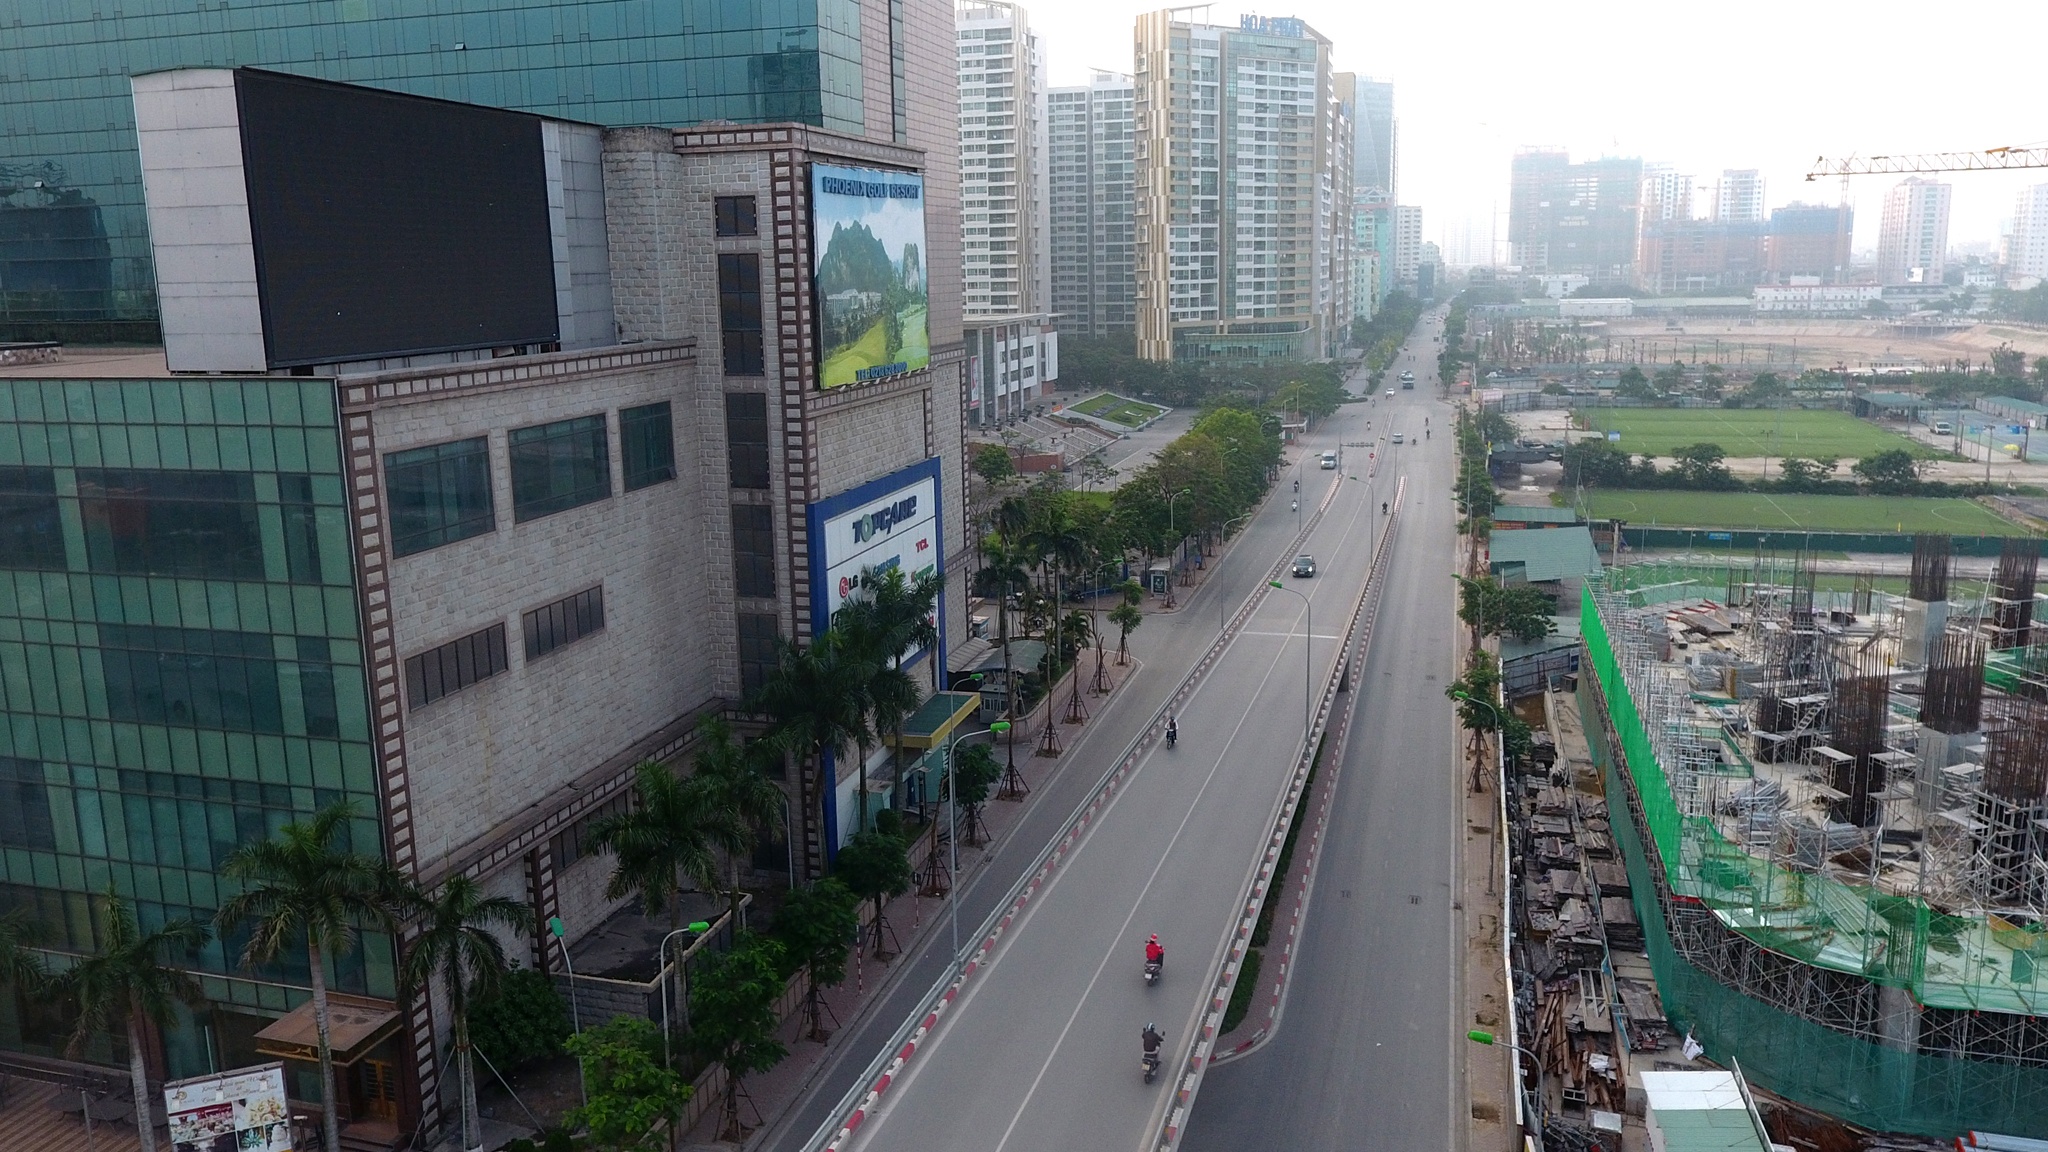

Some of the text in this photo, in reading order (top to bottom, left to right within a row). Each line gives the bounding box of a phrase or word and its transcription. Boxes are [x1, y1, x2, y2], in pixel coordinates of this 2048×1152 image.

[1240, 10, 1305, 38] HÒA PHÁT
[823, 177, 920, 199] PHOENIX GOLF RESORT
[852, 495, 917, 544] TOPCARE
[915, 538, 929, 553] TCL
